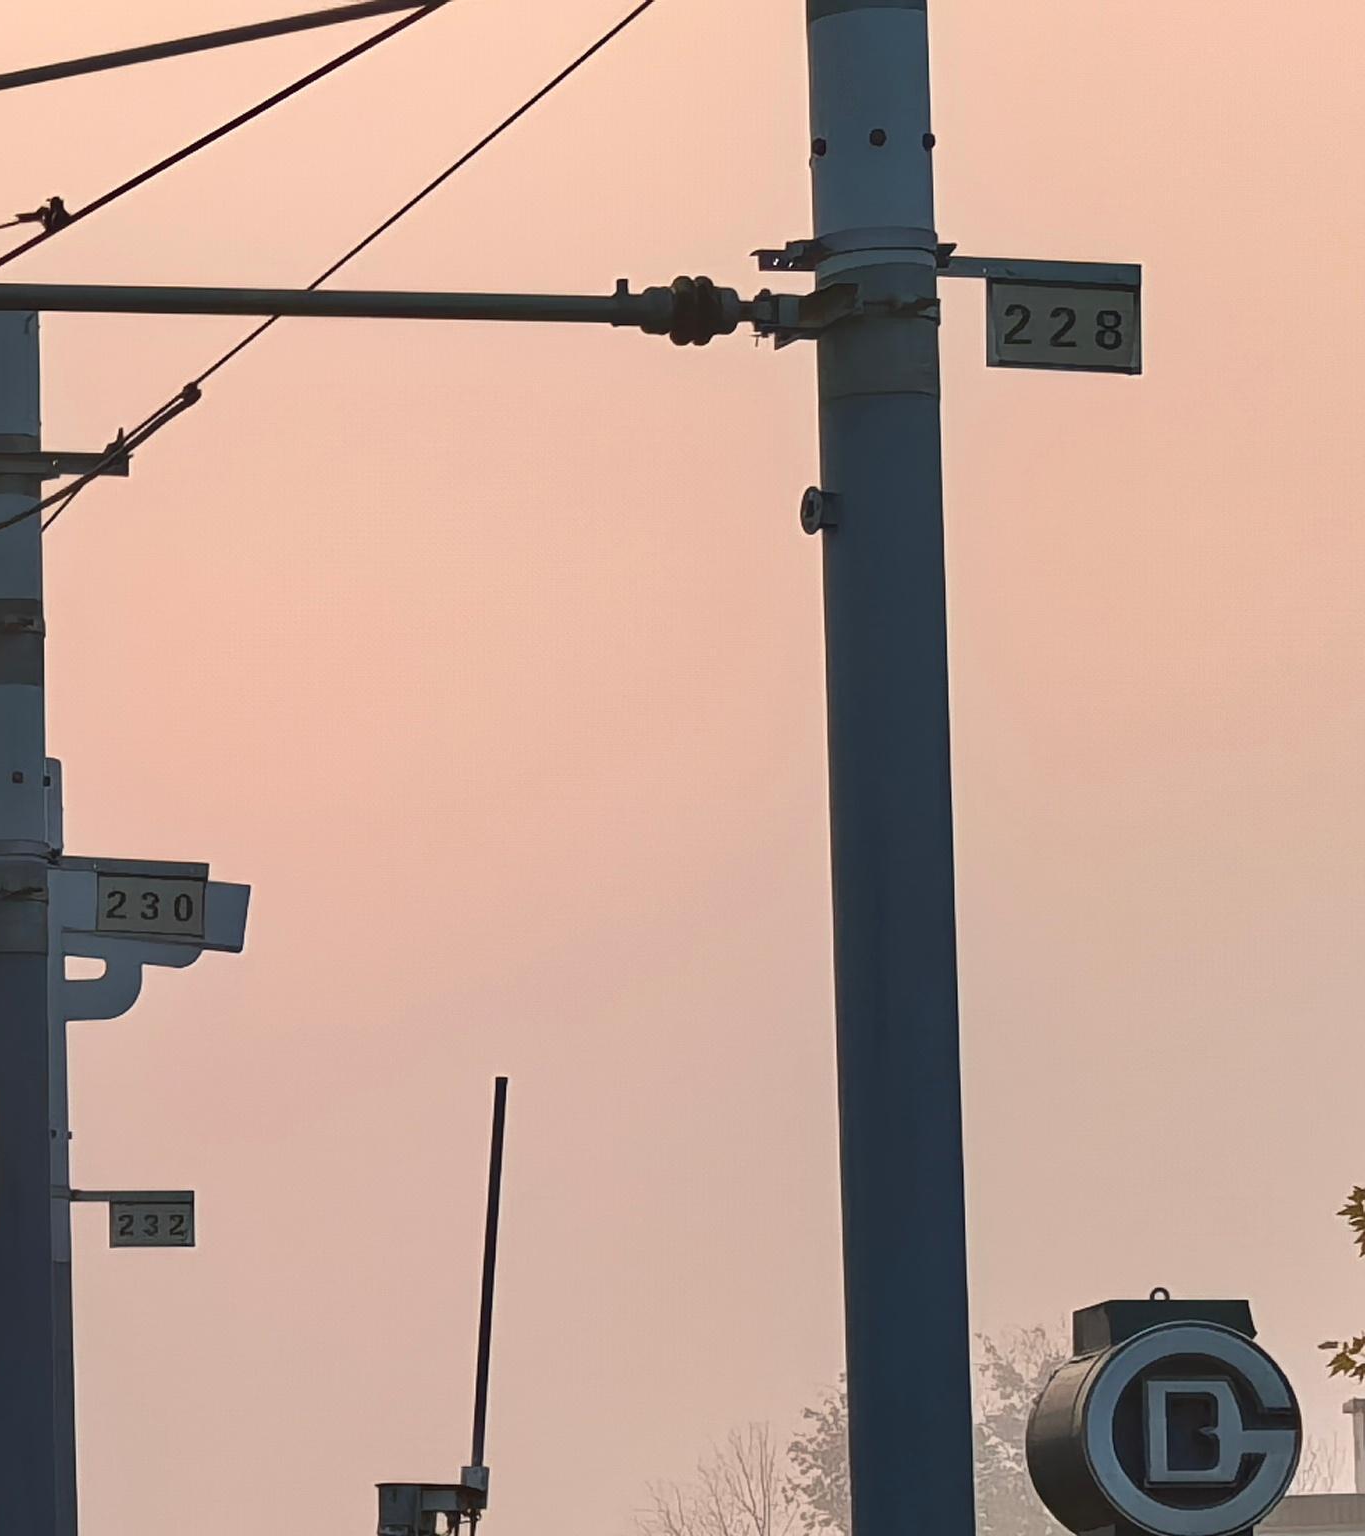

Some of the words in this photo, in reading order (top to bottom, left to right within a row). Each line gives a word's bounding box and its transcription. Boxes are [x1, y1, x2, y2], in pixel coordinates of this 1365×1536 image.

[1003, 303, 1123, 350] 228
[105, 890, 194, 922] 230
[117, 1213, 185, 1237] 232
